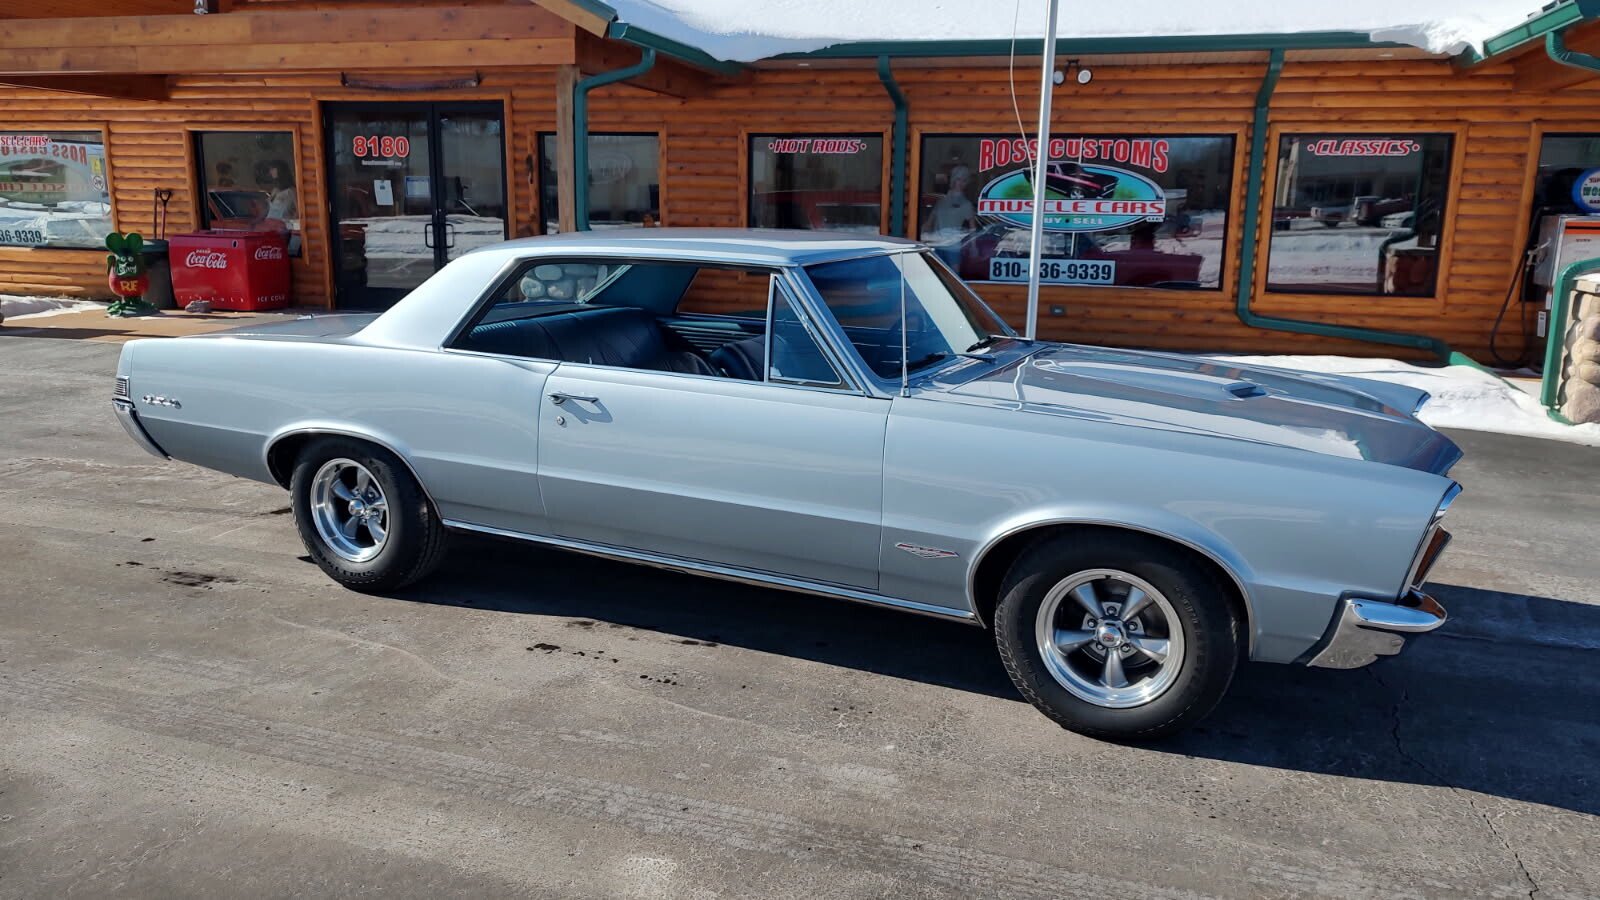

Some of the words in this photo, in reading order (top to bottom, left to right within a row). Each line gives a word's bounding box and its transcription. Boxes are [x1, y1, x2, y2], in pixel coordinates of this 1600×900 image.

[23, 135, 48, 147] CARS
[353, 135, 410, 157] 8180
[774, 139, 811, 153] HOT
[812, 139, 861, 153] RODS
[1315, 140, 1413, 156] CLASSICS
[979, 138, 1040, 172] ROSS
[1049, 138, 1169, 173] CUSTOMS
[1095, 201, 1164, 214] CARS
[1073, 217, 1103, 225] SELL
[992, 261, 1112, 281] 810-36-9339
